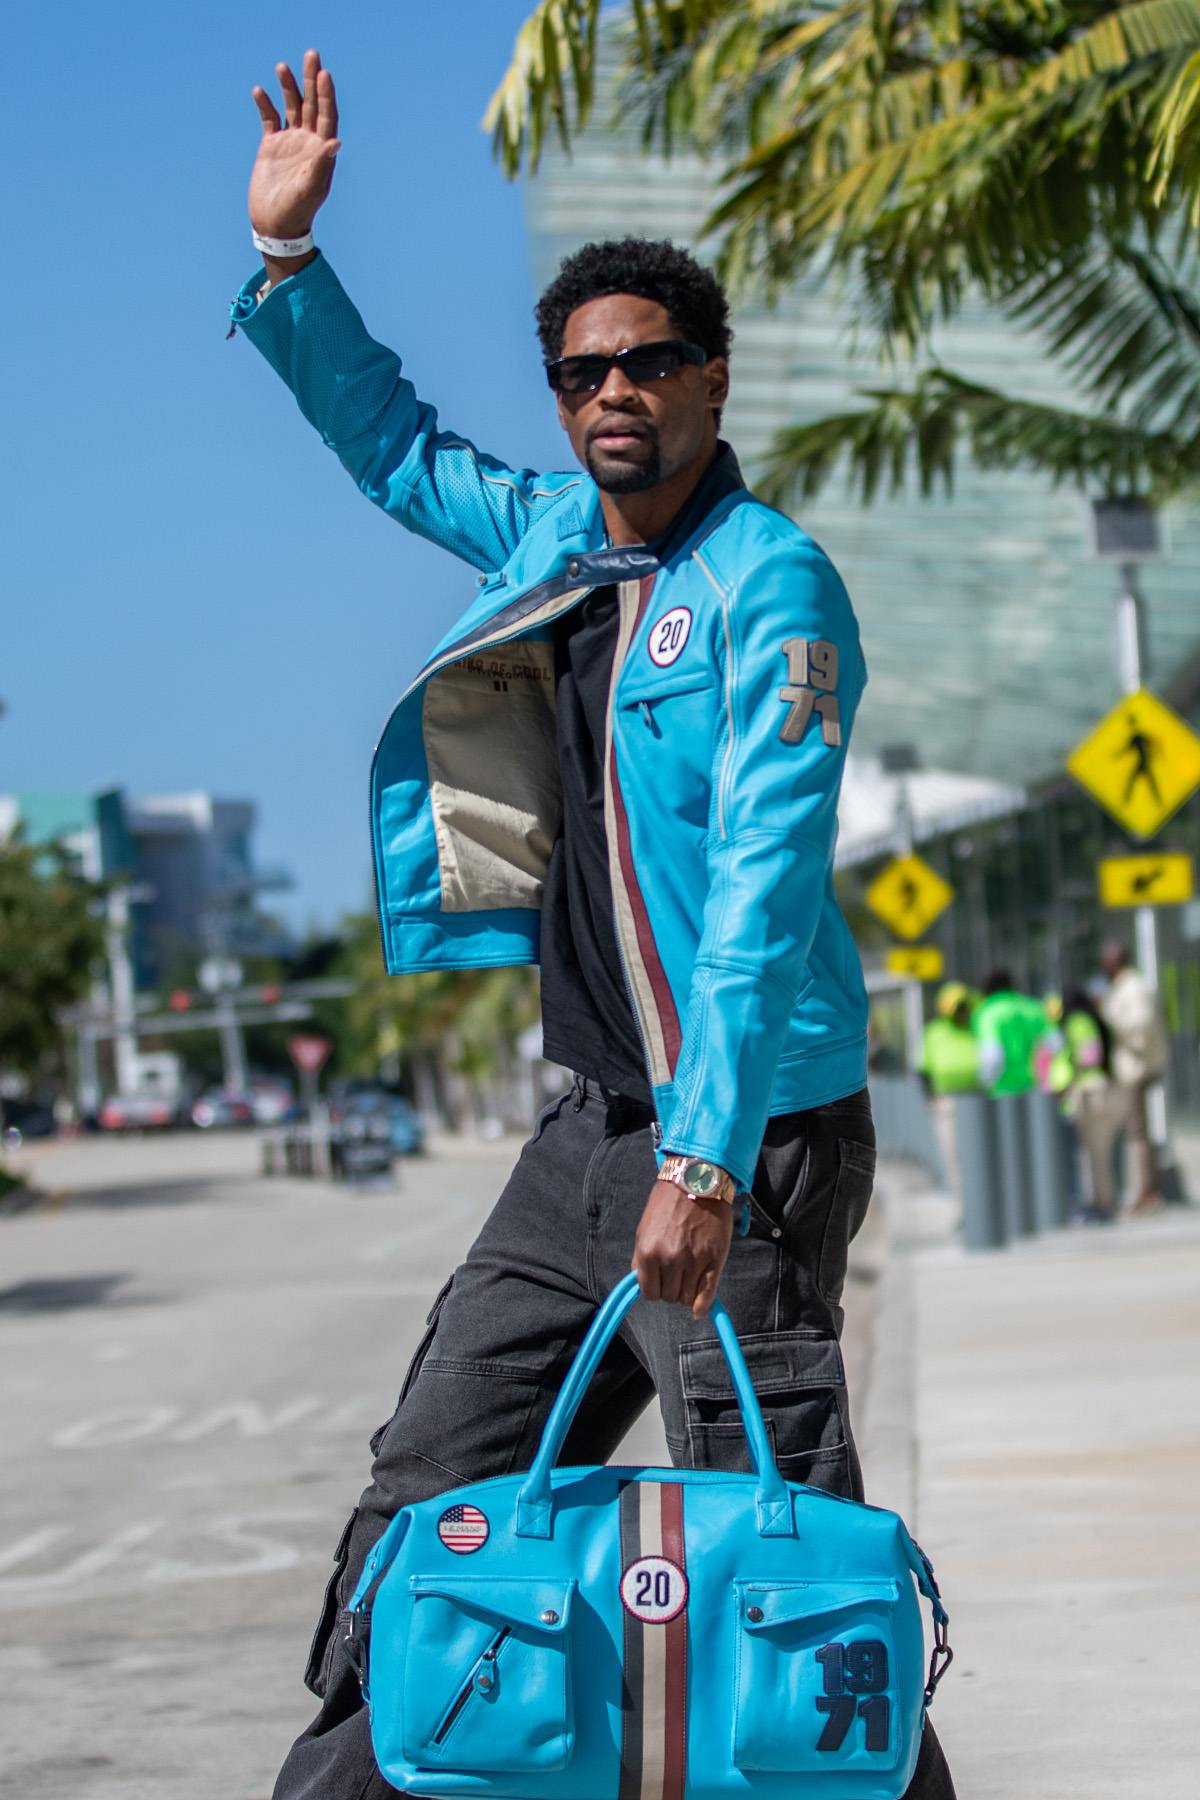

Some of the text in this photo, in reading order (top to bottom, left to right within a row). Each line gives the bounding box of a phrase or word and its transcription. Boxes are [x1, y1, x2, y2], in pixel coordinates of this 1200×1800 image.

[658, 618, 683, 653] 20
[490, 660, 507, 673] OF
[782, 637, 838, 691] 19
[780, 687, 841, 746] 71
[636, 1570, 670, 1607] 20
[815, 1641, 889, 1695] 19
[815, 1694, 890, 1752] 71
